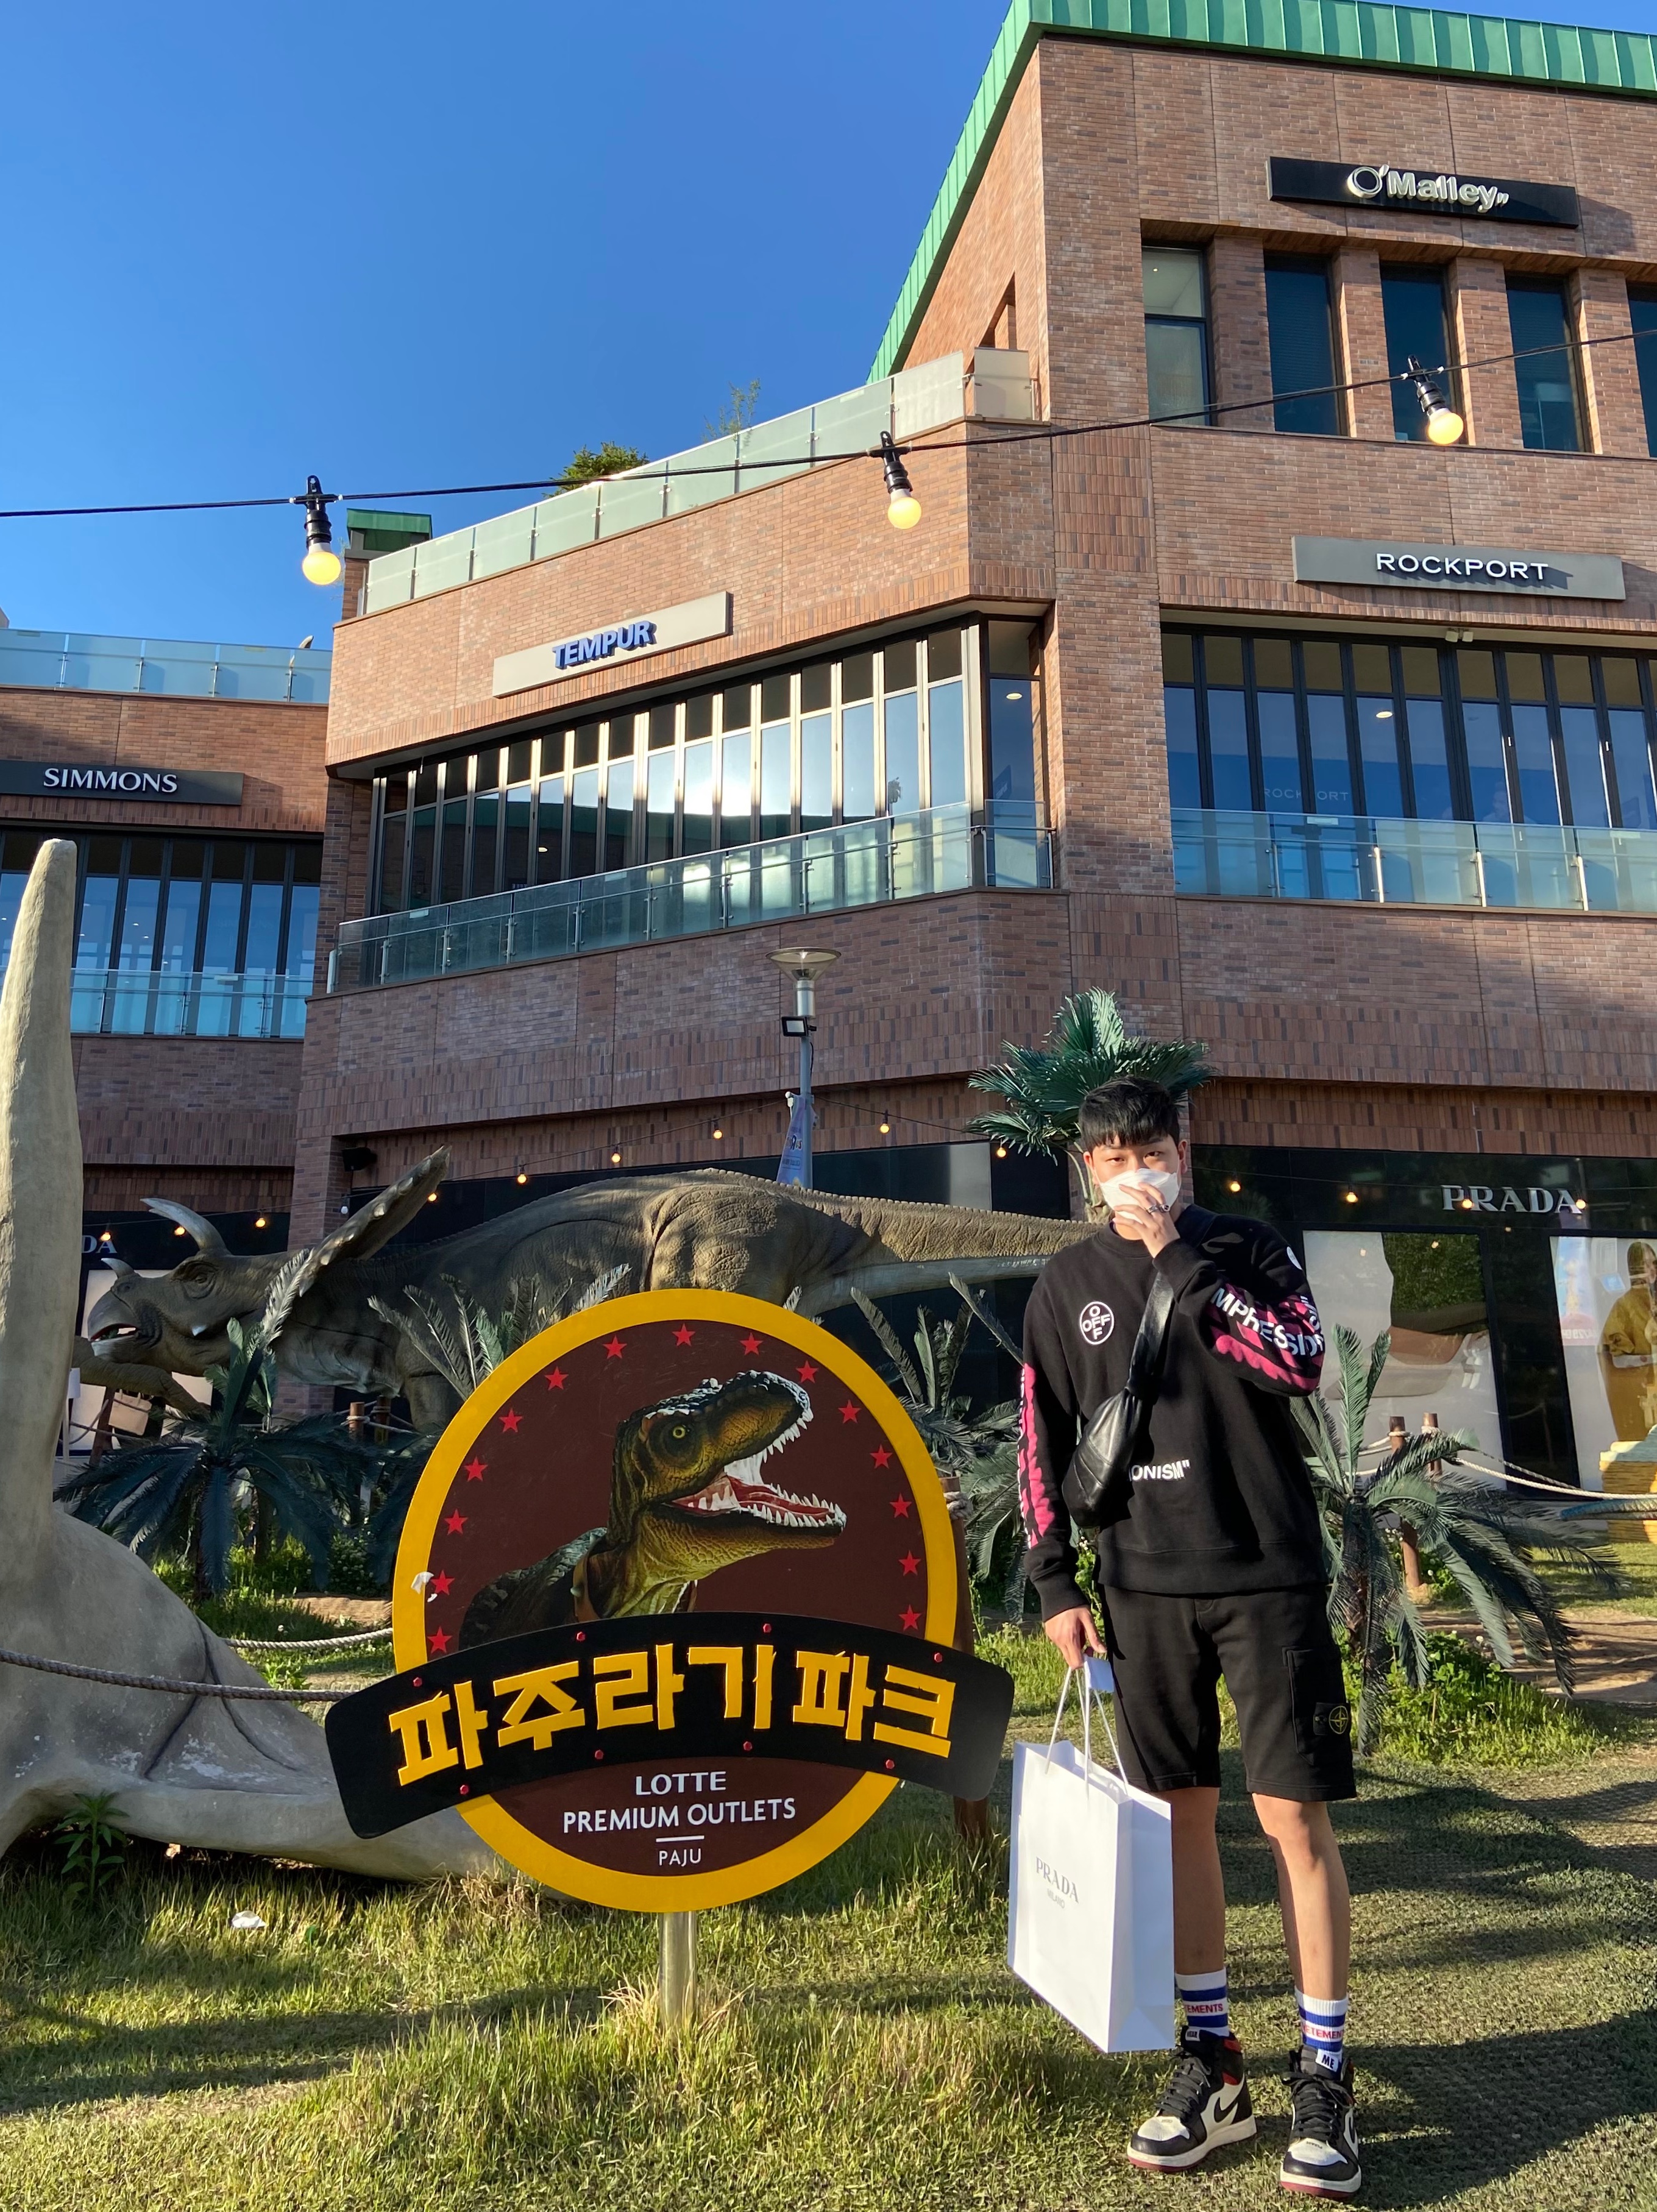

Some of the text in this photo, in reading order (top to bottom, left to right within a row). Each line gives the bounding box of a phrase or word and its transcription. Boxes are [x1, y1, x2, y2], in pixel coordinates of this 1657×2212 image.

[1376, 553, 1549, 580] ROCKPORT
[552, 620, 656, 670] TEMPUR
[43, 768, 178, 793] SIMMONS
[1440, 1185, 1583, 1214] PRADA
[388, 1642, 957, 1787] 파주라기 파크
[636, 1771, 726, 1795] LOTTE
[563, 1797, 796, 1834] PREMIUM OUTLETS
[659, 1848, 702, 1867] PAJU
[1036, 1856, 1079, 1904] PRADA
[1046, 1888, 1065, 1909] MILANO
[1321, 2054, 1335, 2069] ME
